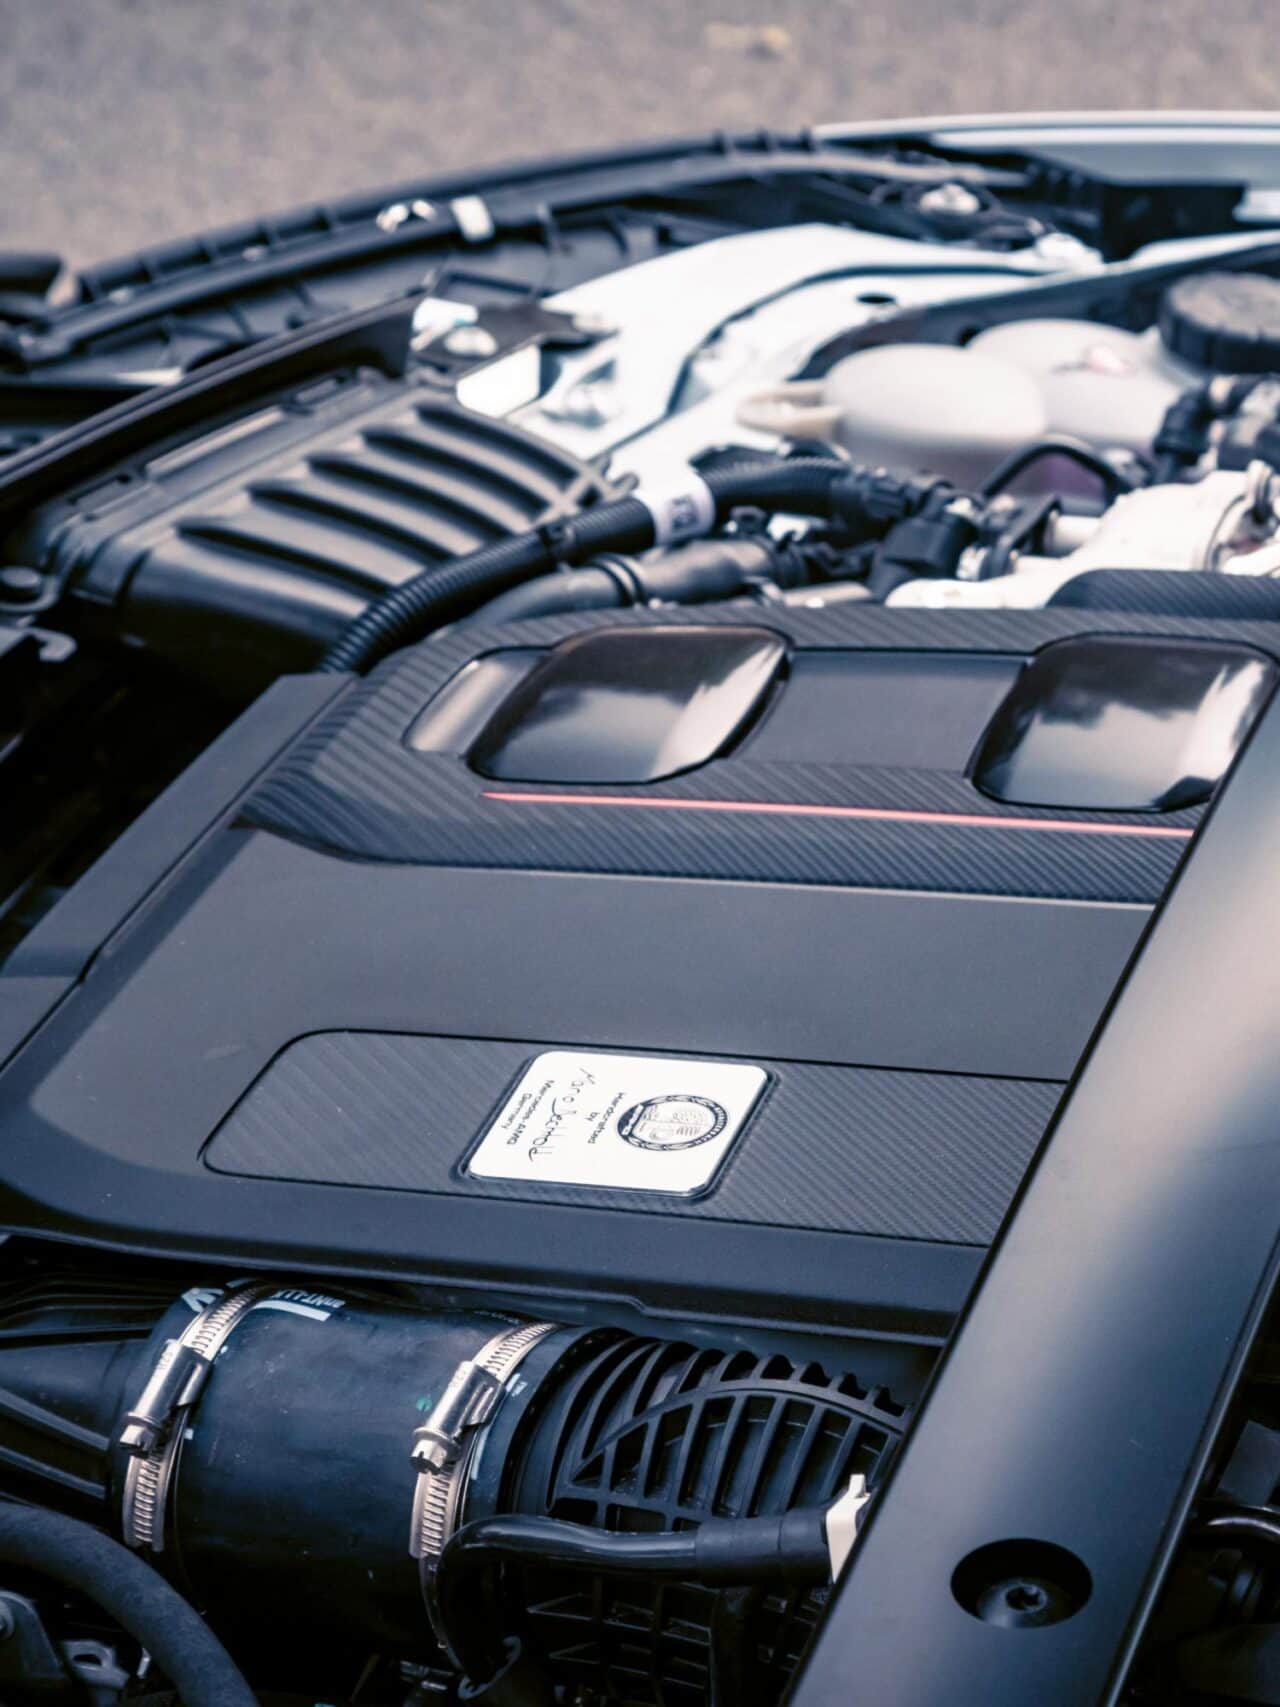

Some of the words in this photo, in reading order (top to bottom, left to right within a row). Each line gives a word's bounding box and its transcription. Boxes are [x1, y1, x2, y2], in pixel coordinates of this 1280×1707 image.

[500, 1092, 534, 1130] Germany
[506, 1079, 556, 1146] Mercedes-AMG
[586, 1111, 601, 1123] by
[587, 1091, 626, 1145] Handcrafted
